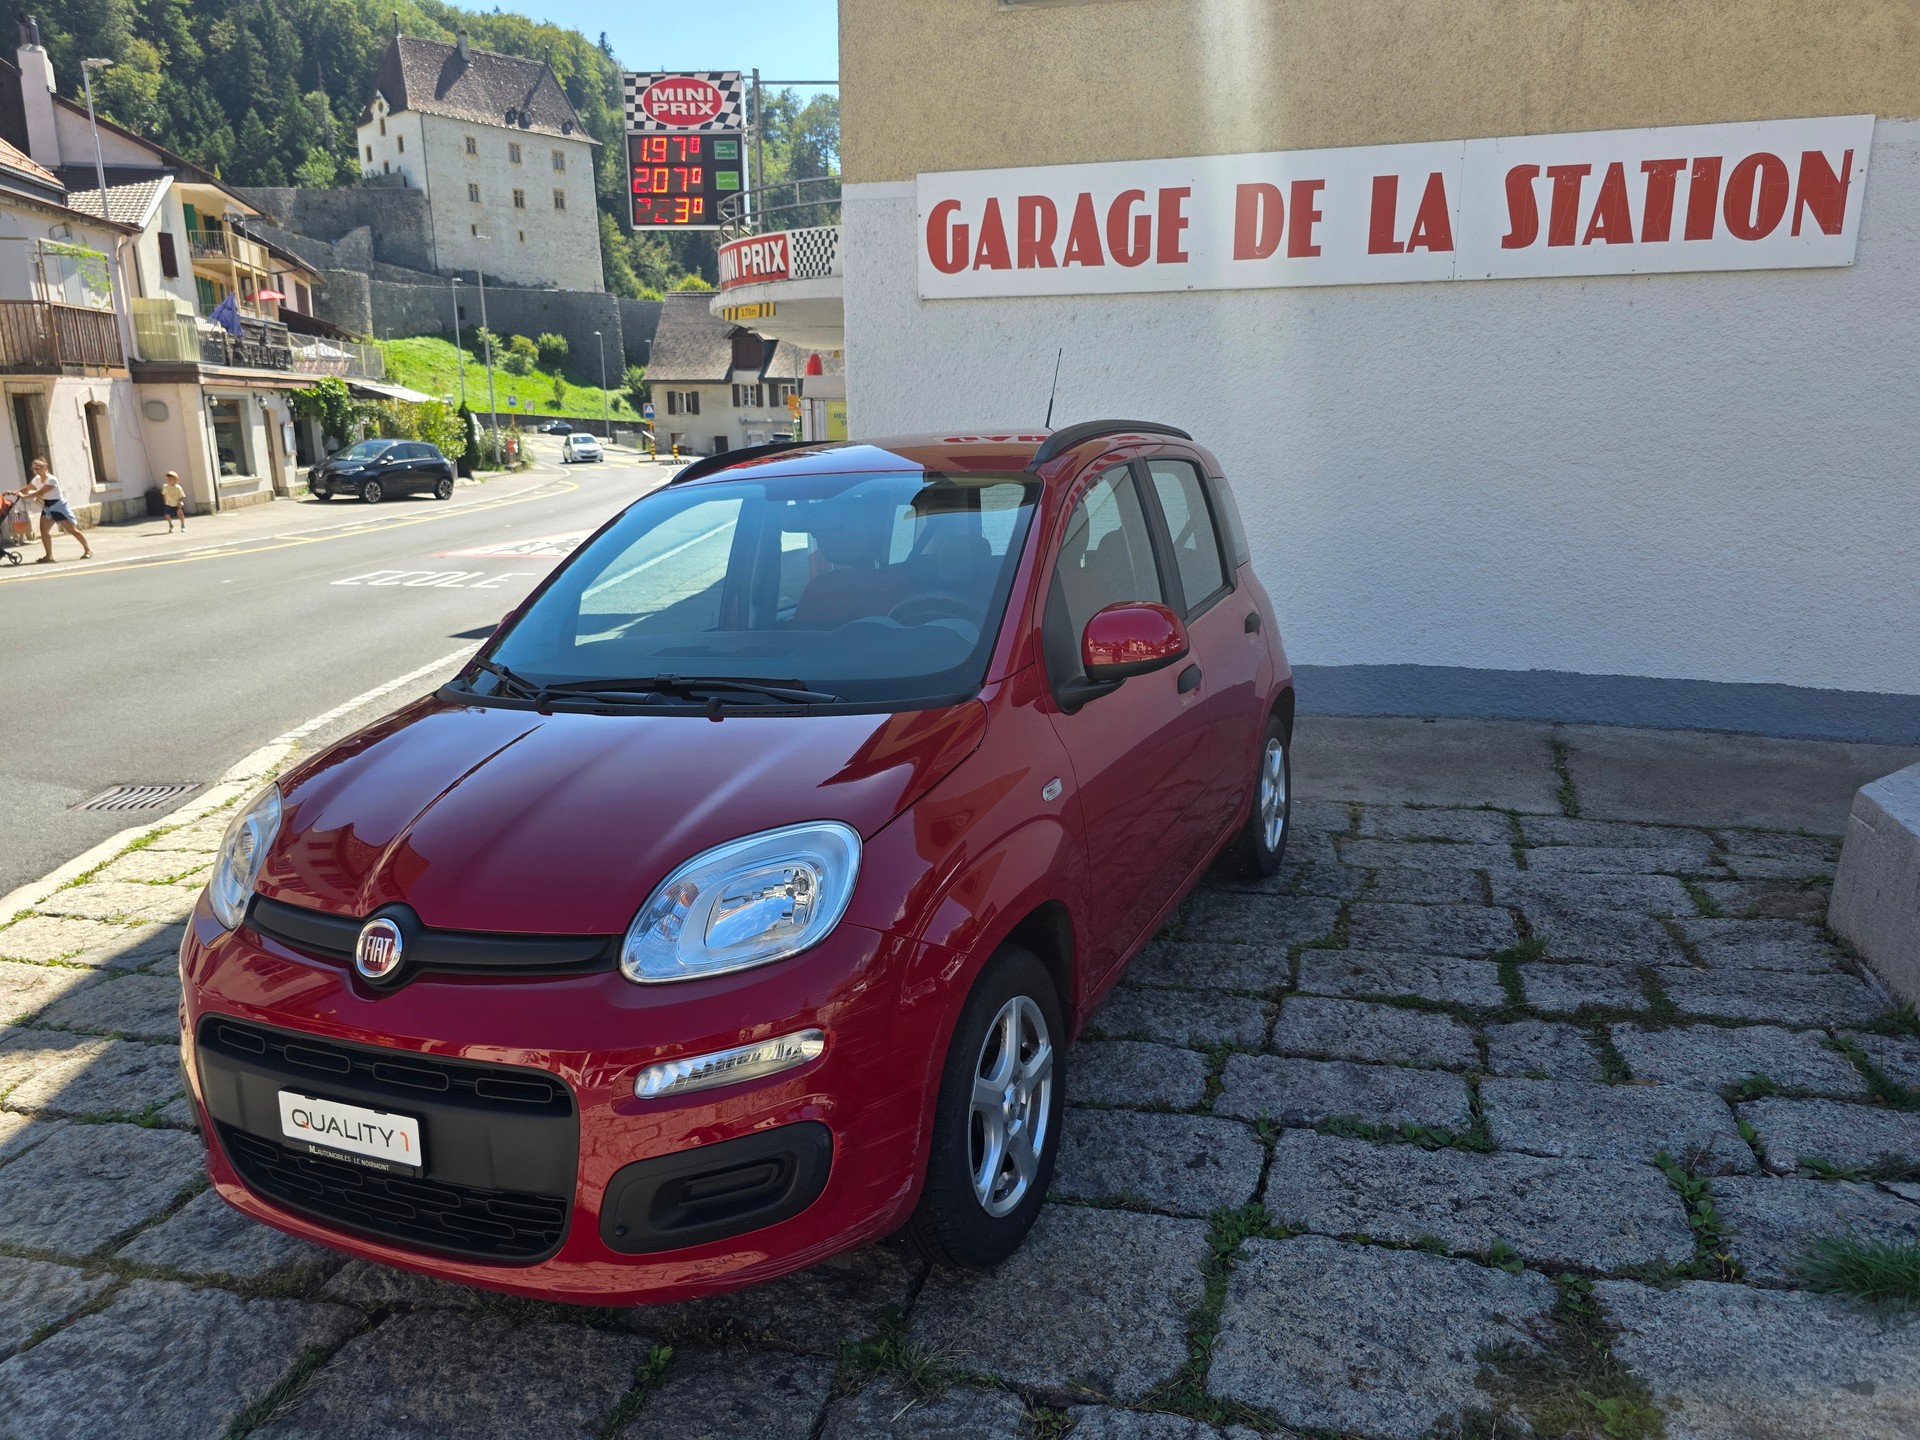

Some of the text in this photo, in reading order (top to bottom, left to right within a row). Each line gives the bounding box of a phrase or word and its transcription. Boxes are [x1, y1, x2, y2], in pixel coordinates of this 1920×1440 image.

[651, 88, 714, 102] MINI
[652, 102, 715, 116] PRIX
[927, 149, 1854, 274] GARAGE DE LA STATION
[741, 240, 786, 277] PRIX
[364, 935, 392, 963] FIAT
[353, 1157, 361, 1165] LE
[361, 1159, 390, 1171] NOIRMONT
